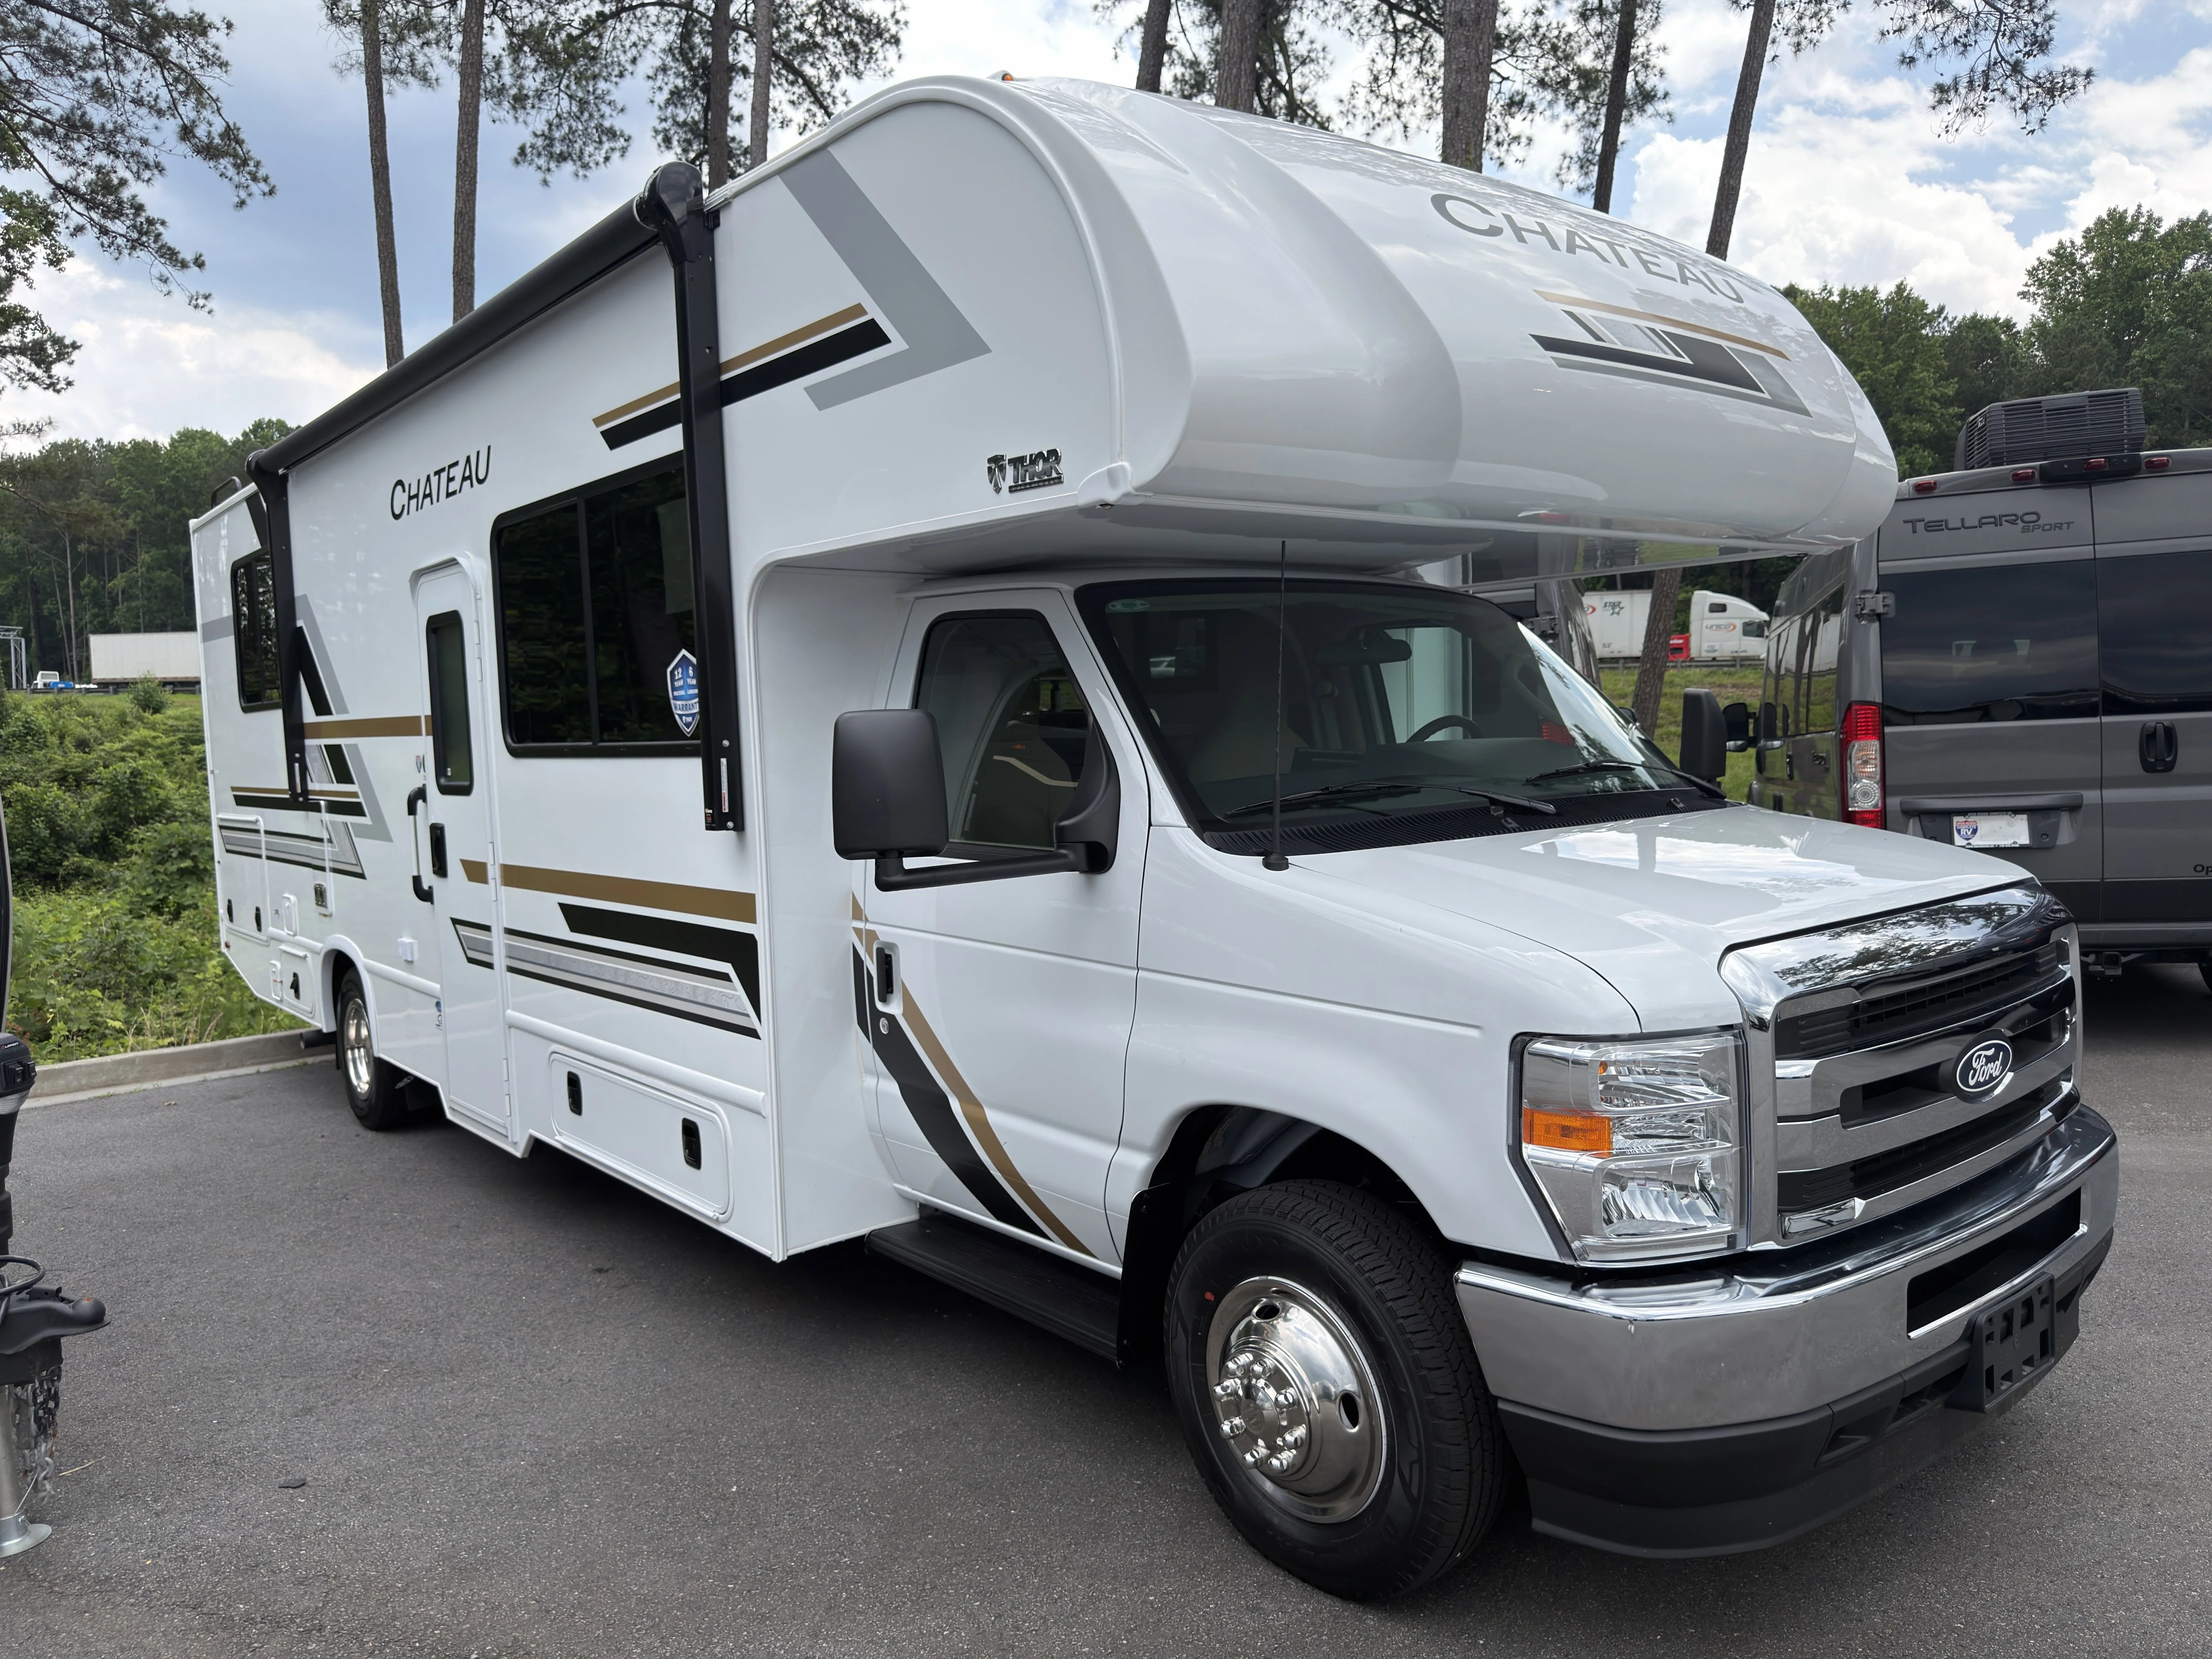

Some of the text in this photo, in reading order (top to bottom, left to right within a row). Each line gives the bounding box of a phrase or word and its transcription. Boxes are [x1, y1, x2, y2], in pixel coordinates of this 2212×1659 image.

[1431, 193, 1744, 304] CHATEAU
[1008, 448, 1063, 484] THOR
[391, 445, 492, 521] CHATEAU
[1902, 511, 2041, 534] TELLARO
[2020, 521, 2075, 533] SPORT
[674, 667, 682, 679] 12
[689, 666, 693, 677] 6
[674, 679, 684, 687] YEAR
[673, 702, 697, 712] WARRANT
[1968, 1047, 2003, 1086] Ford
